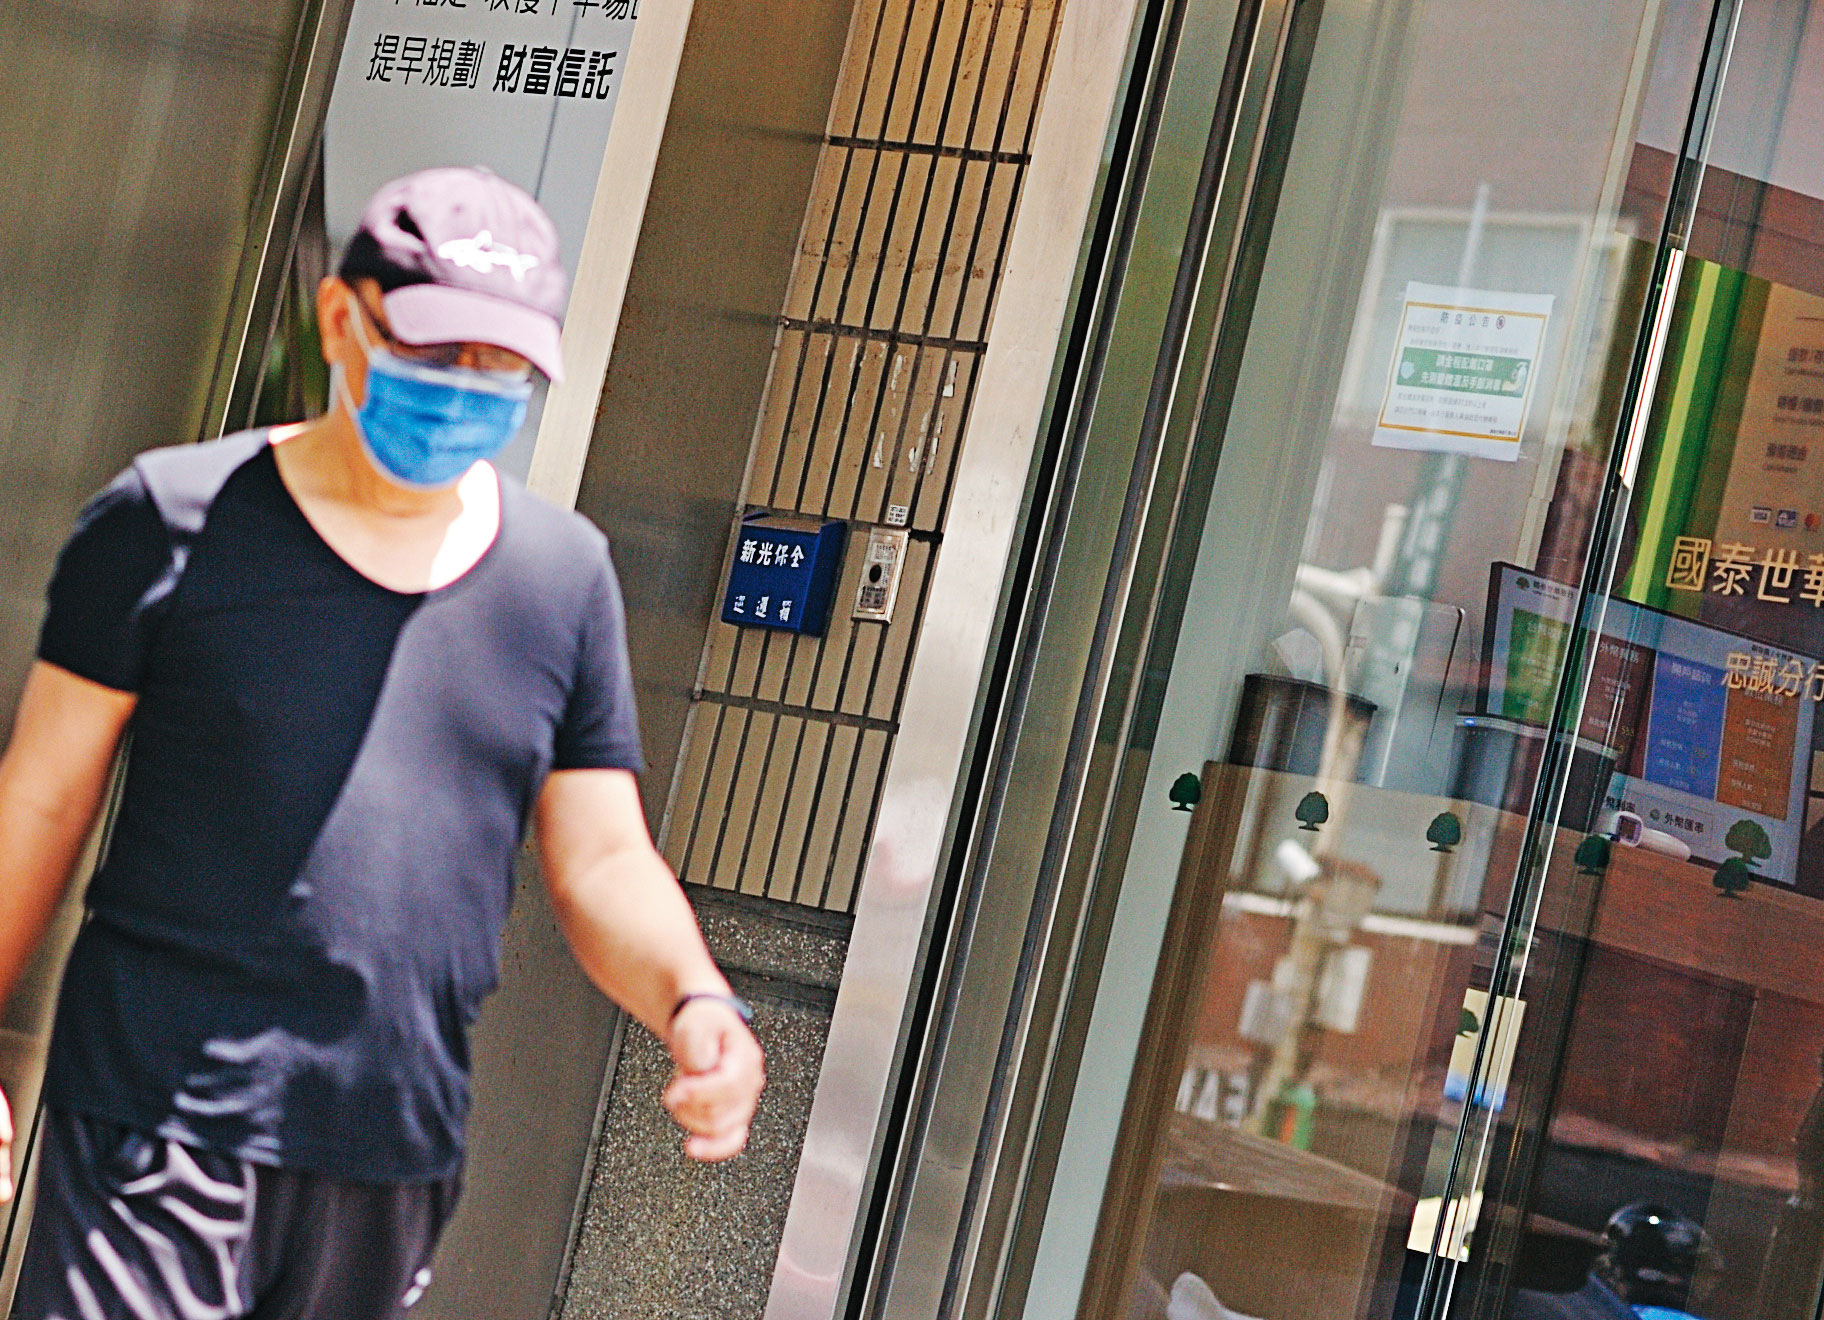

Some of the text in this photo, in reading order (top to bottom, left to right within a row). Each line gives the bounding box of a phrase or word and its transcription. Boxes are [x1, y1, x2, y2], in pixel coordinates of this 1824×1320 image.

[366, 32, 617, 101] 提早規劃 財富信託
[739, 538, 805, 568] 新光保全
[1665, 536, 1824, 608] 國泰世華
[1721, 651, 1824, 702] 忠誠分行
